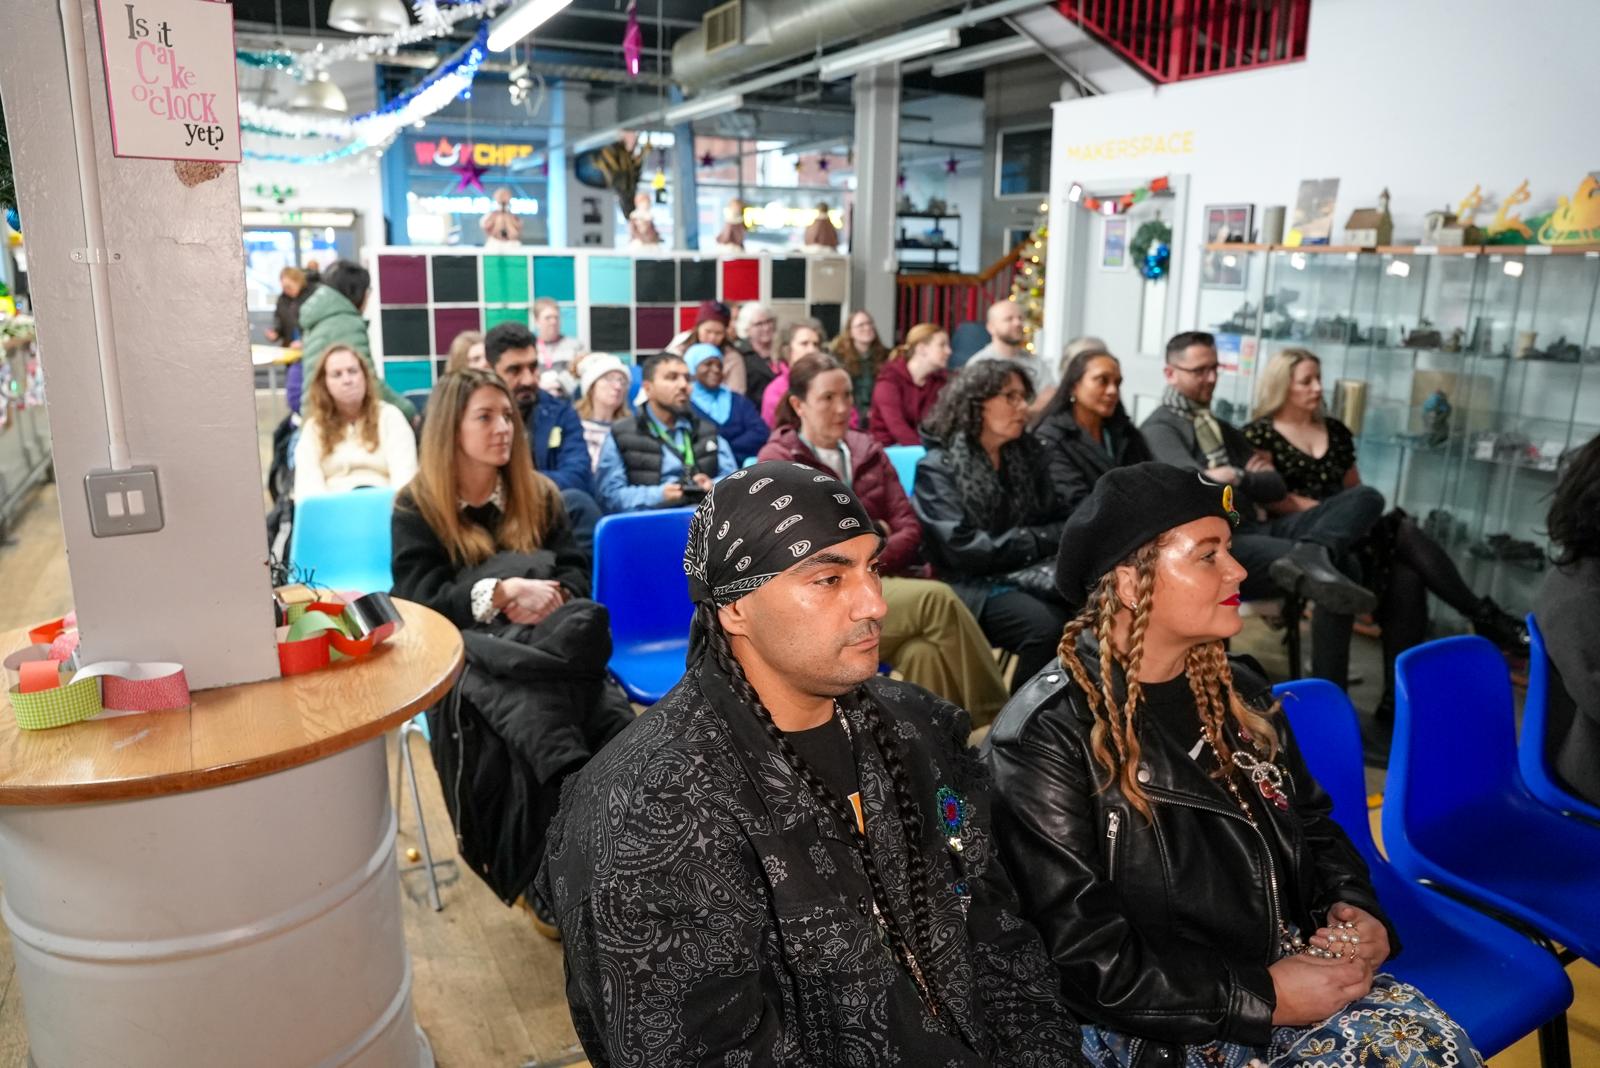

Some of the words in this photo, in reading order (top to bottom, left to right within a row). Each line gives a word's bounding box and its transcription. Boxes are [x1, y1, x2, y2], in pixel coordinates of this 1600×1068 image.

[124, 4, 150, 40] Is
[157, 21, 174, 48] it
[135, 40, 196, 91] Cake
[184, 123, 225, 151] yet?
[1066, 129, 1195, 161] MAKERSPACE
